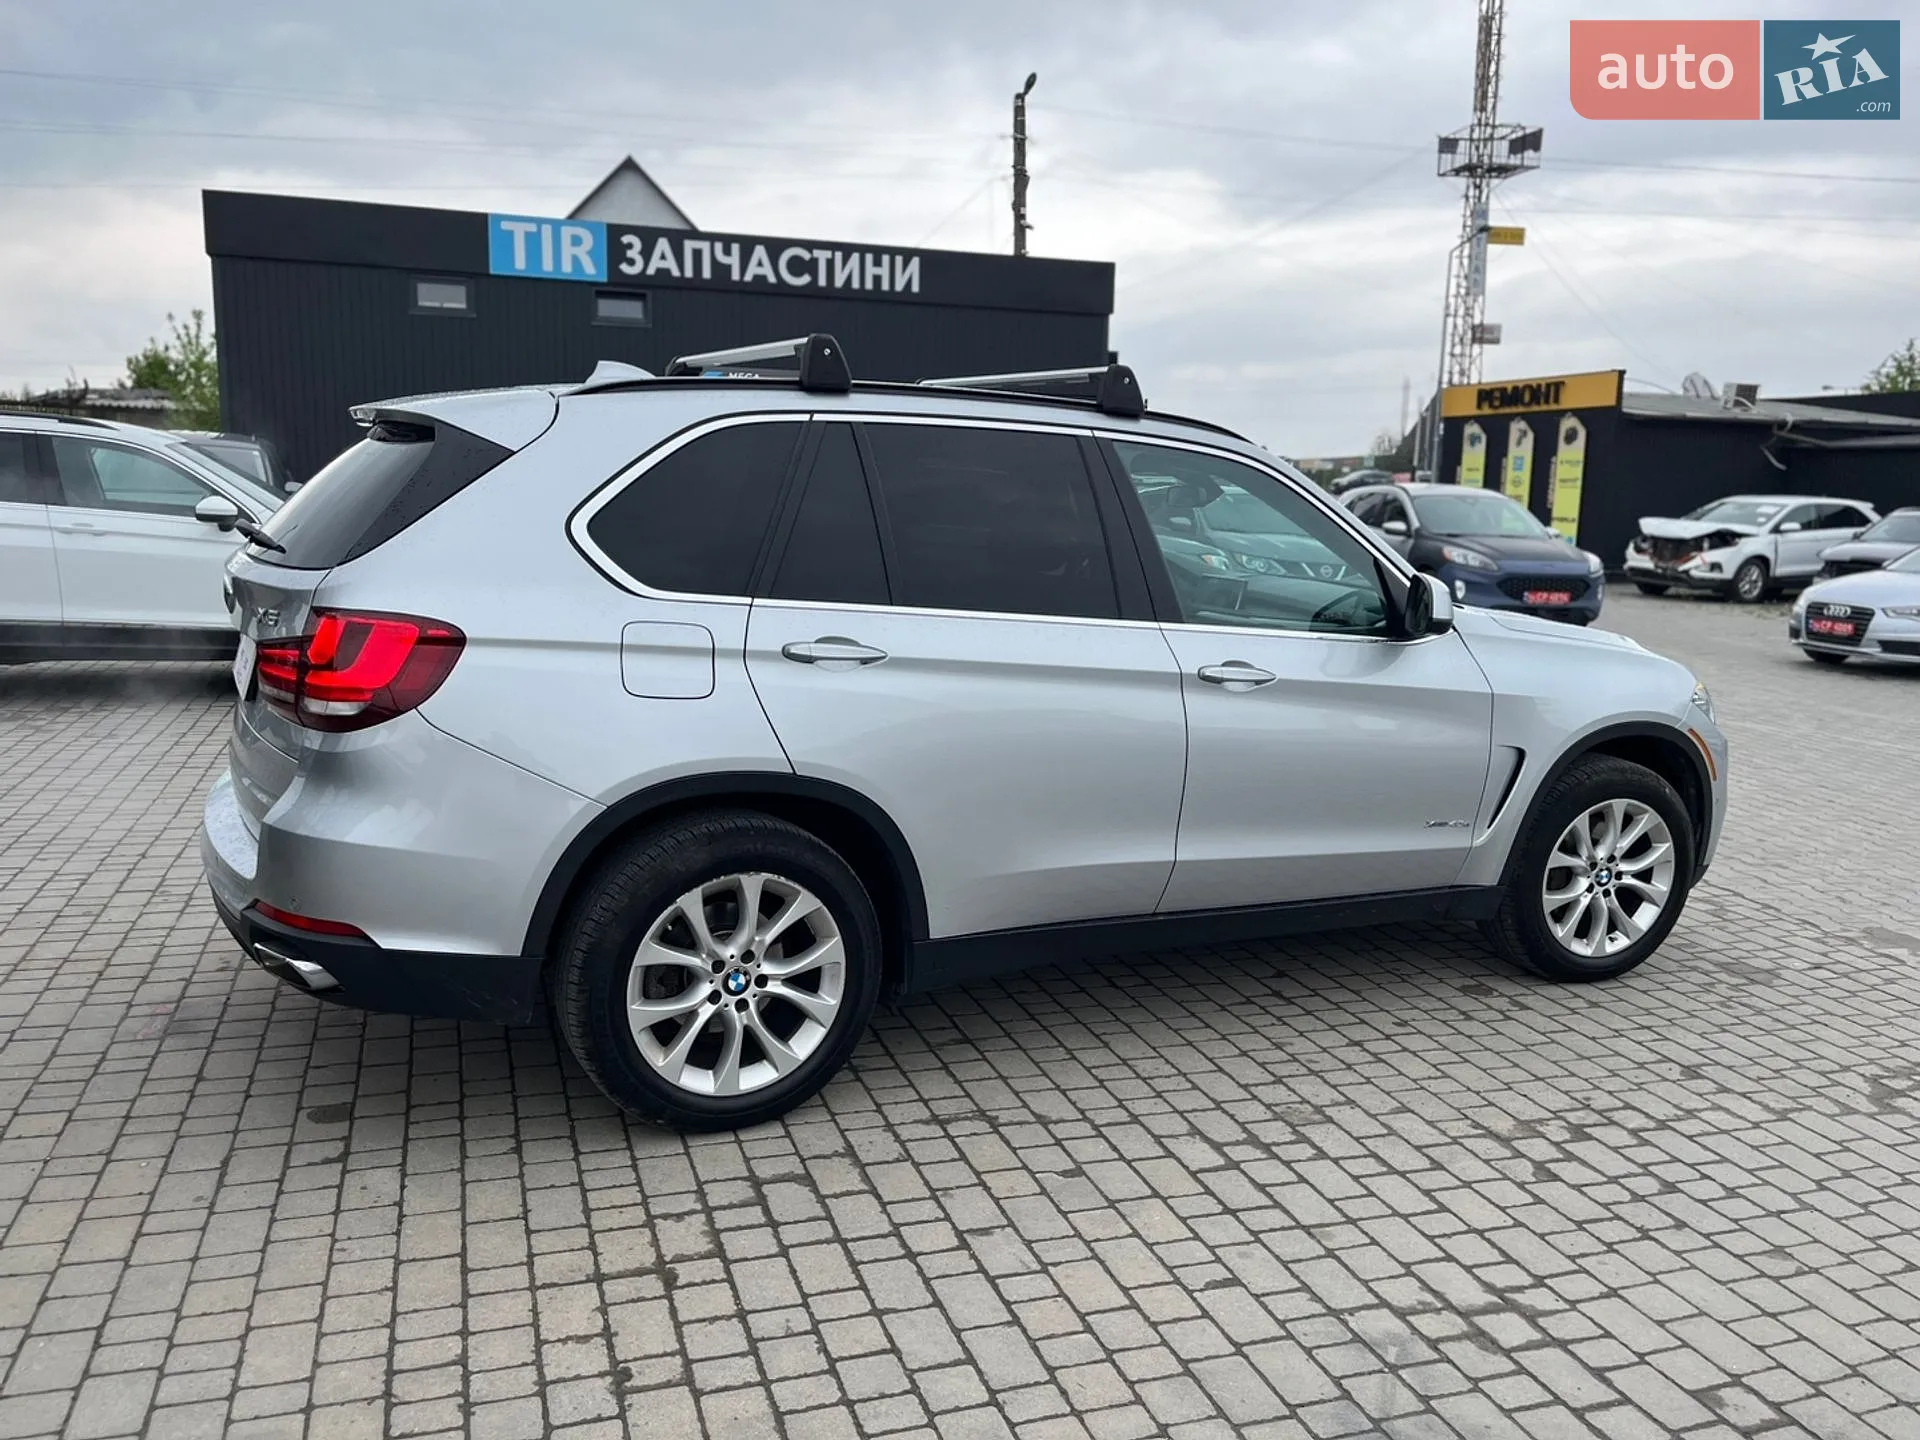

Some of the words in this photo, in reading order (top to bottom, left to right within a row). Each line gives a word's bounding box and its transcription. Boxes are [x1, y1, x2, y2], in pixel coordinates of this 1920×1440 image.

[500, 219, 597, 275] TIR
[618, 234, 921, 294] ЗАПЧАСТИНИ
[1476, 380, 1566, 411] РЕМОНТ
[256, 606, 281, 627] X5
